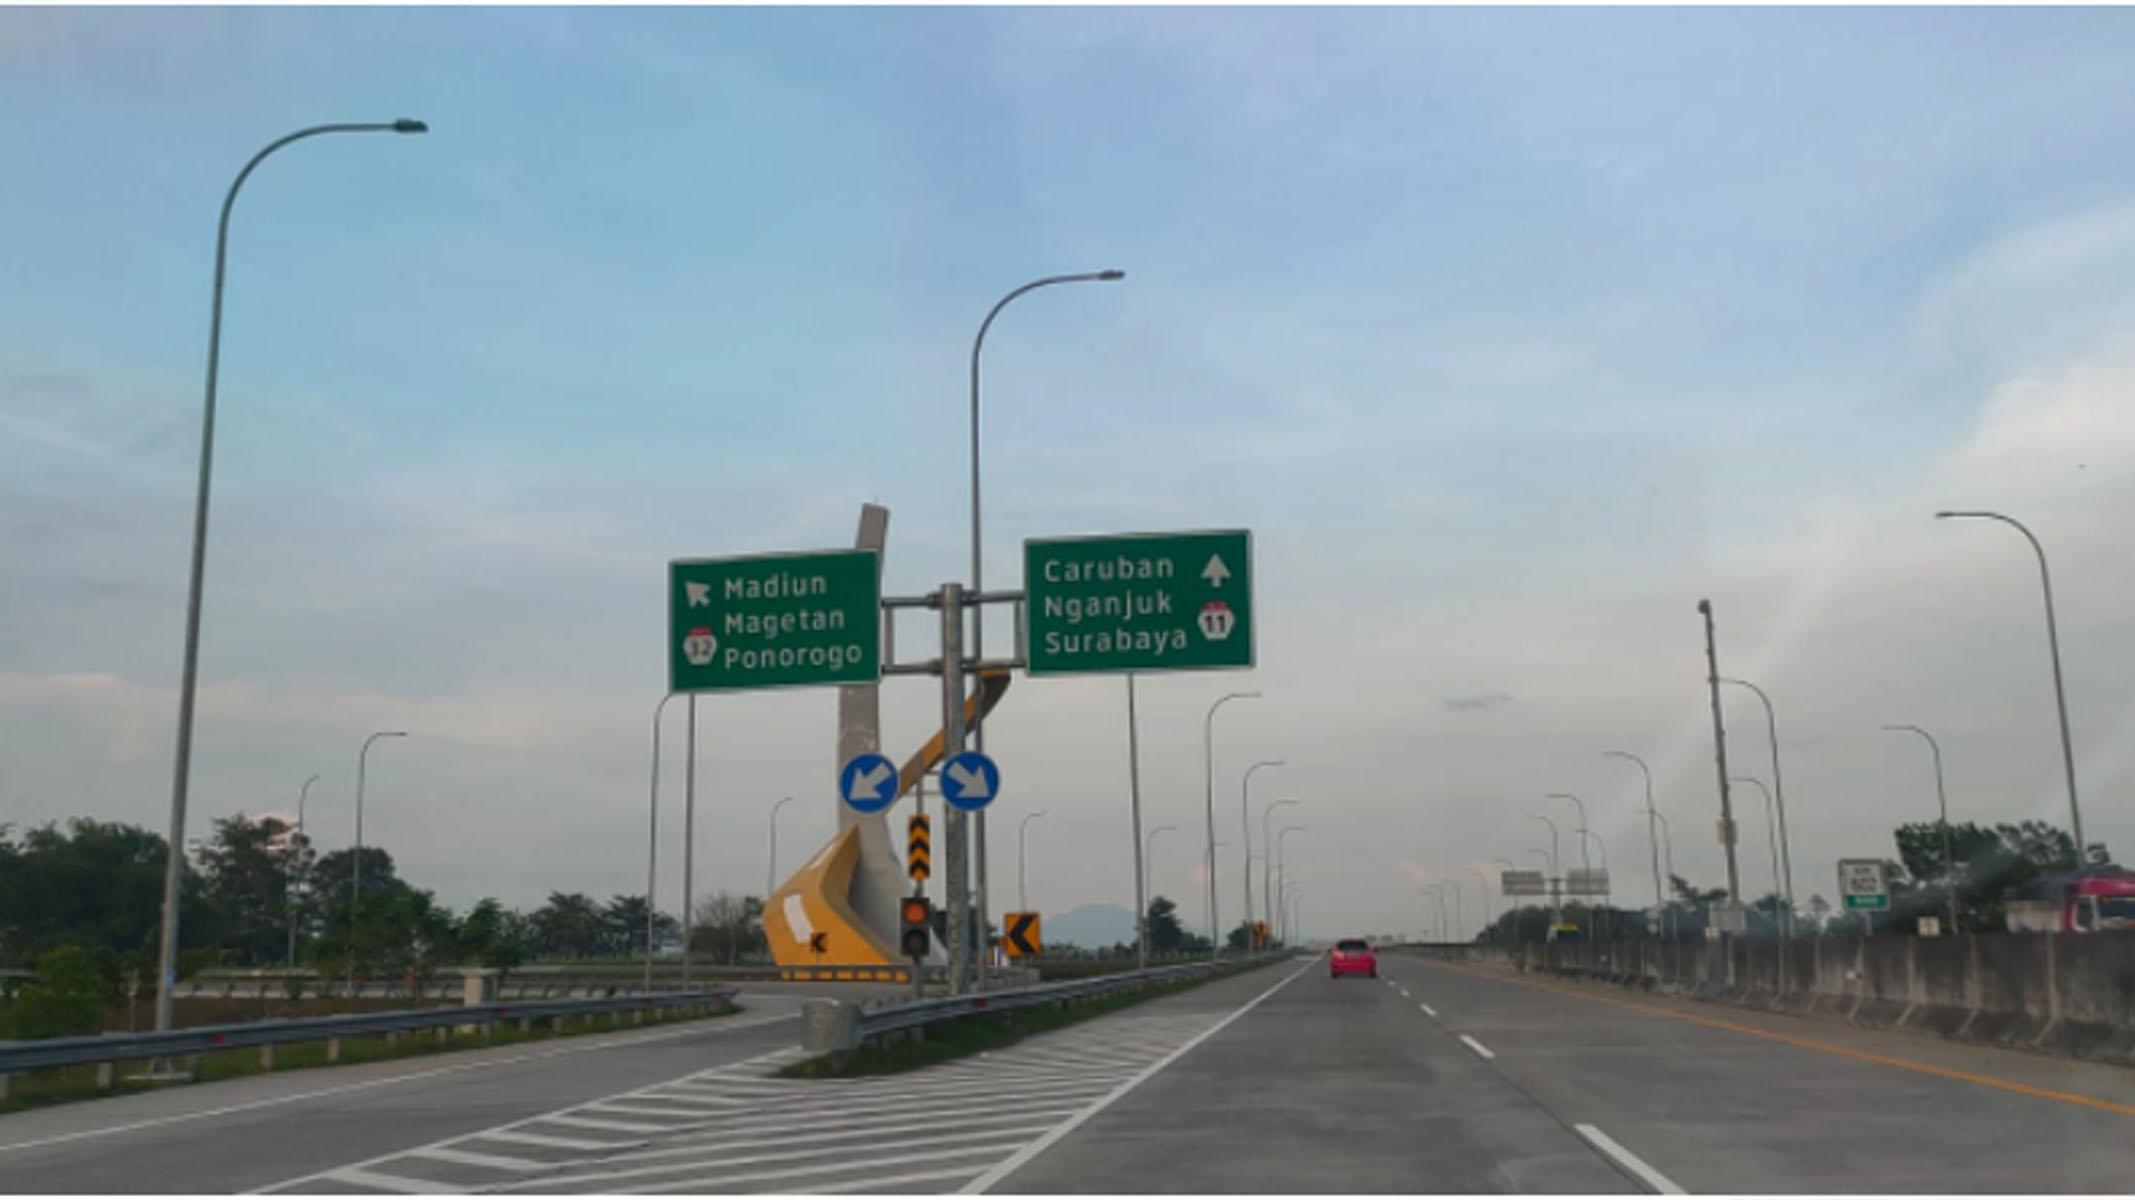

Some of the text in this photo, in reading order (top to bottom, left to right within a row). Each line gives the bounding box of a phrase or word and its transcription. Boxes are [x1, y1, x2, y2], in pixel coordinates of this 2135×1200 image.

[1044, 554, 1174, 582] Caruban
[724, 571, 827, 599] Madiun
[1044, 589, 1173, 624] Nganjuk
[724, 608, 846, 639] Magetan
[1203, 614, 1225, 633] 11
[1044, 627, 1188, 656] Surabaya
[724, 644, 863, 671] Ponorogo
